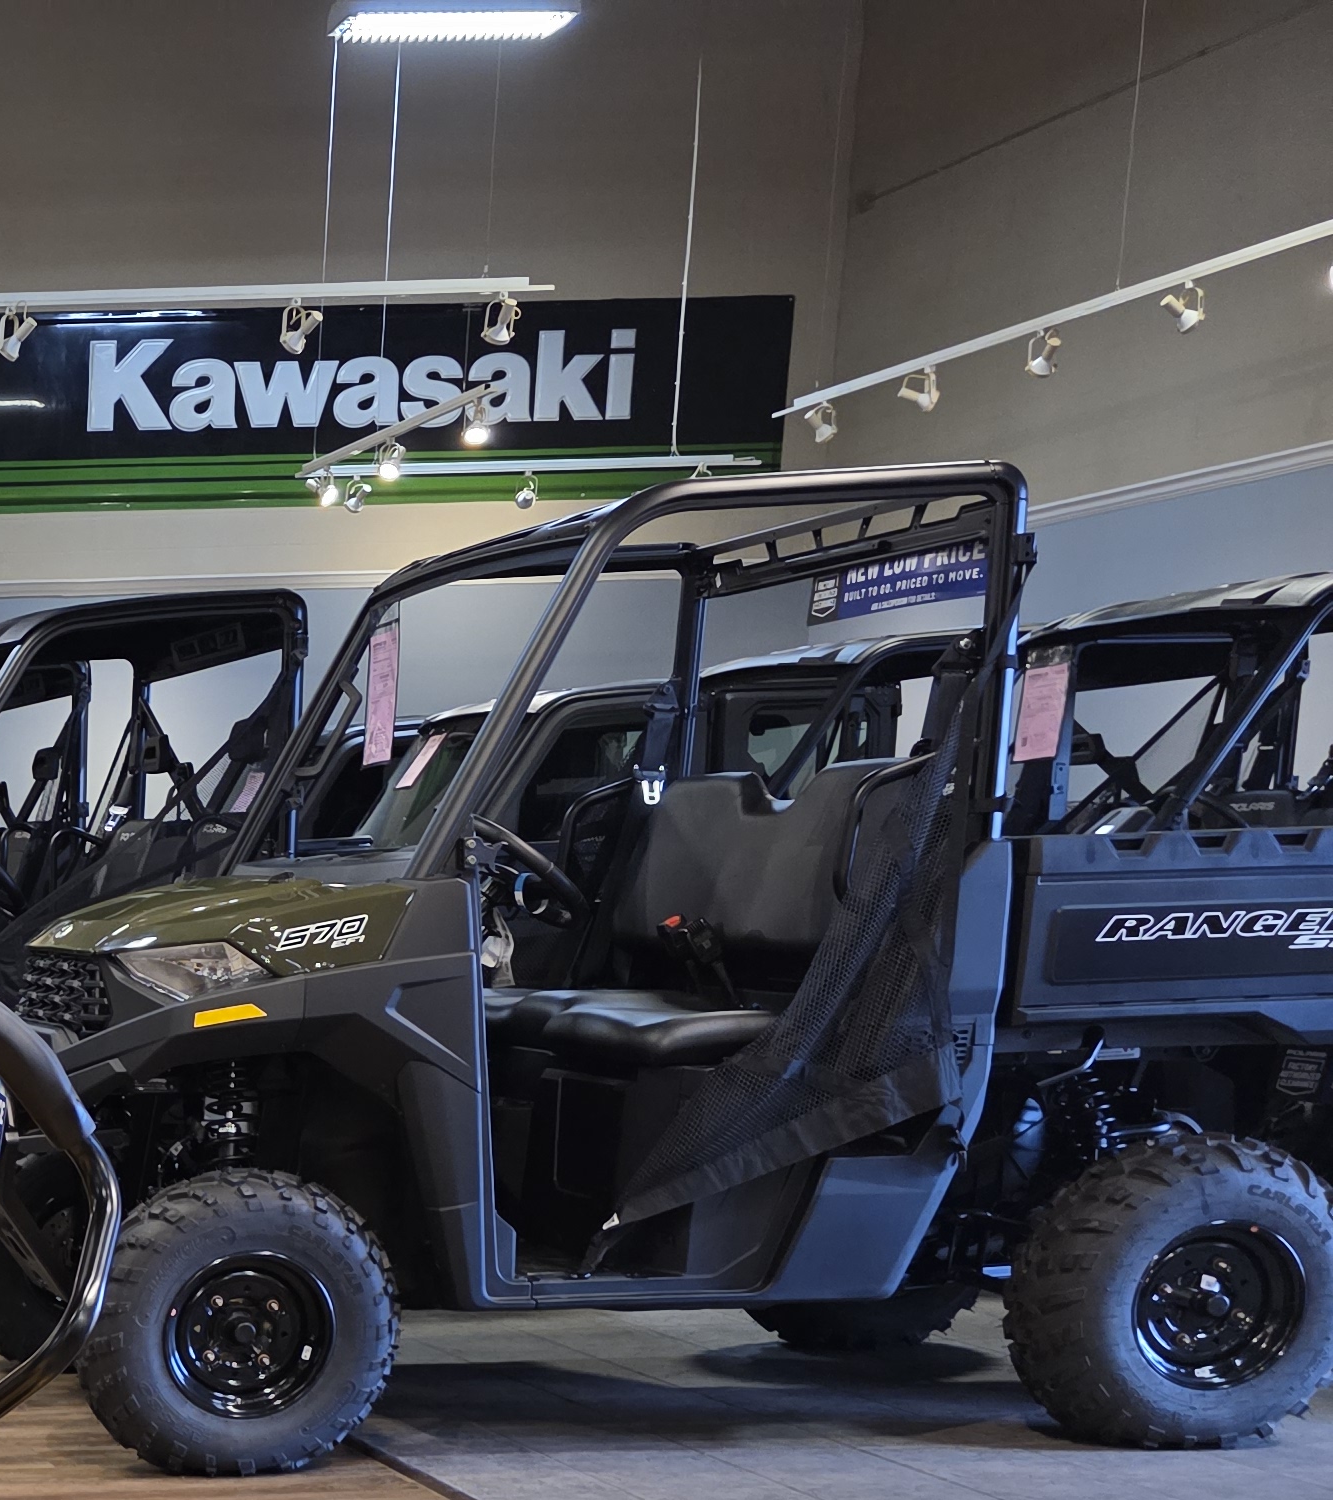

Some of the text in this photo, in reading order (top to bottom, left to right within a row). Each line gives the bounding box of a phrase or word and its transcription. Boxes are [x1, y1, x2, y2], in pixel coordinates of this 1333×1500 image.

[86, 328, 637, 432] Kawasaki
[846, 541, 986, 585] NEW LOW PRICE
[843, 588, 866, 603] BUILT
[868, 586, 878, 597] TO
[896, 575, 928, 592] PRICED
[932, 574, 945, 585] TO
[948, 567, 984, 583] MOVE.
[276, 914, 369, 951] 570
[330, 934, 366, 949] EFI
[1095, 907, 1333, 942] RANGE
